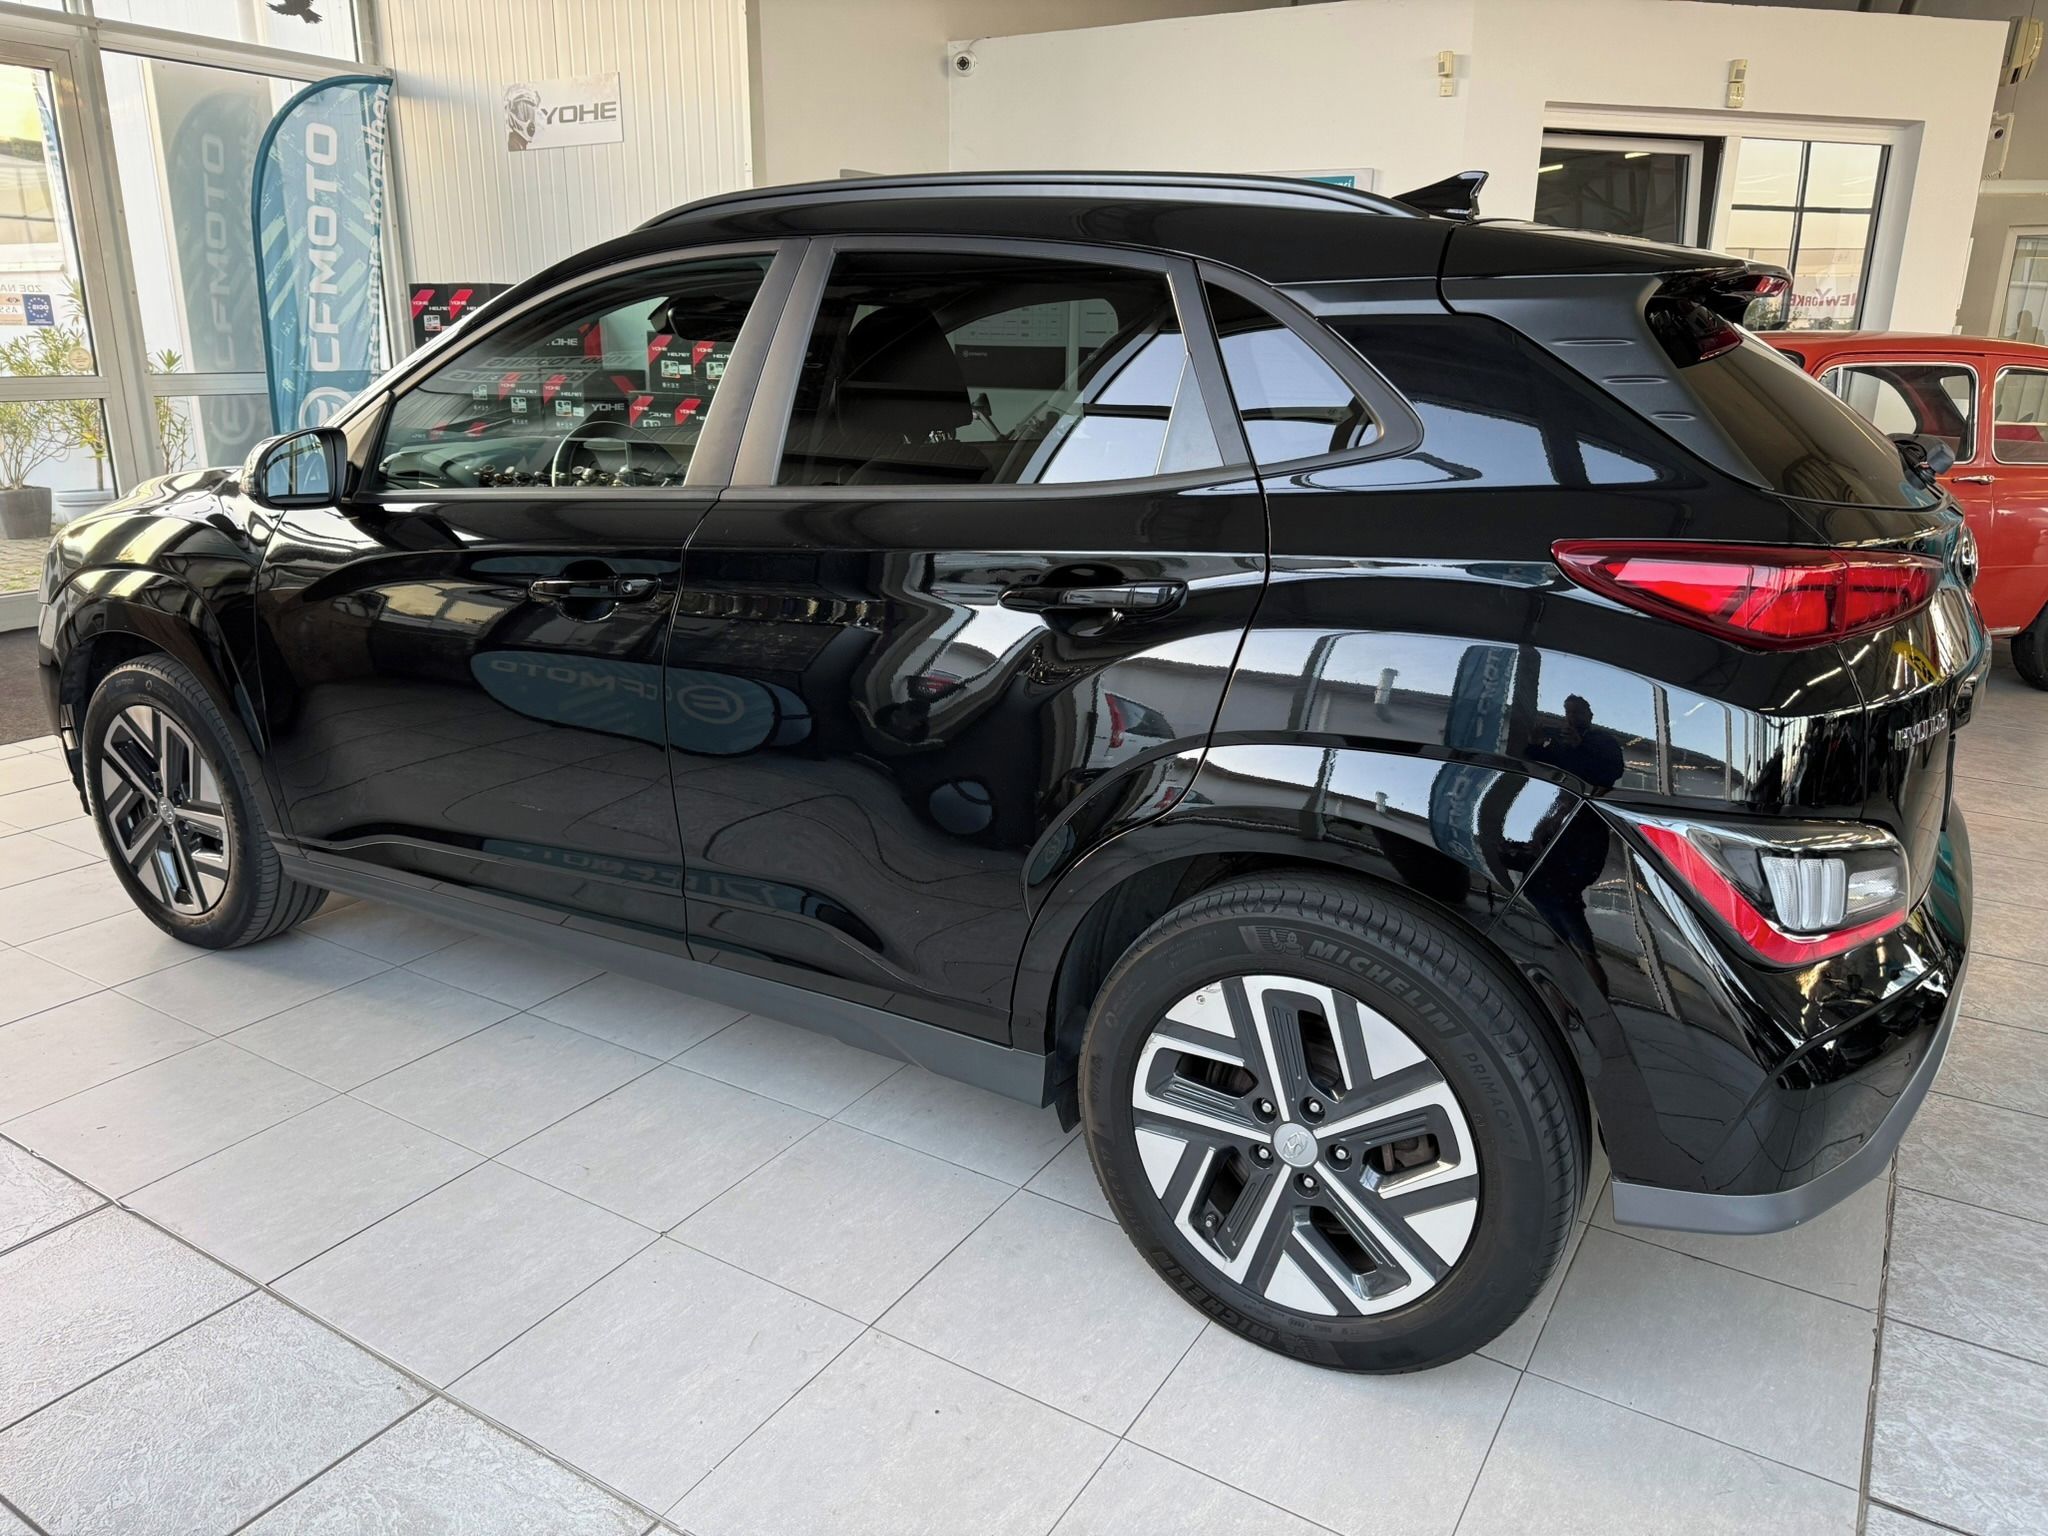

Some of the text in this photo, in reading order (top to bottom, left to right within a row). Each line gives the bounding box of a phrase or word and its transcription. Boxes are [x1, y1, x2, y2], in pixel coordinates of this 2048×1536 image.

[541, 101, 616, 125] YOHE
[305, 121, 339, 371] CFMOTO
[546, 338, 578, 346] OHE
[591, 403, 625, 411] YOHE
[1307, 940, 1457, 1033] MICHELIN
